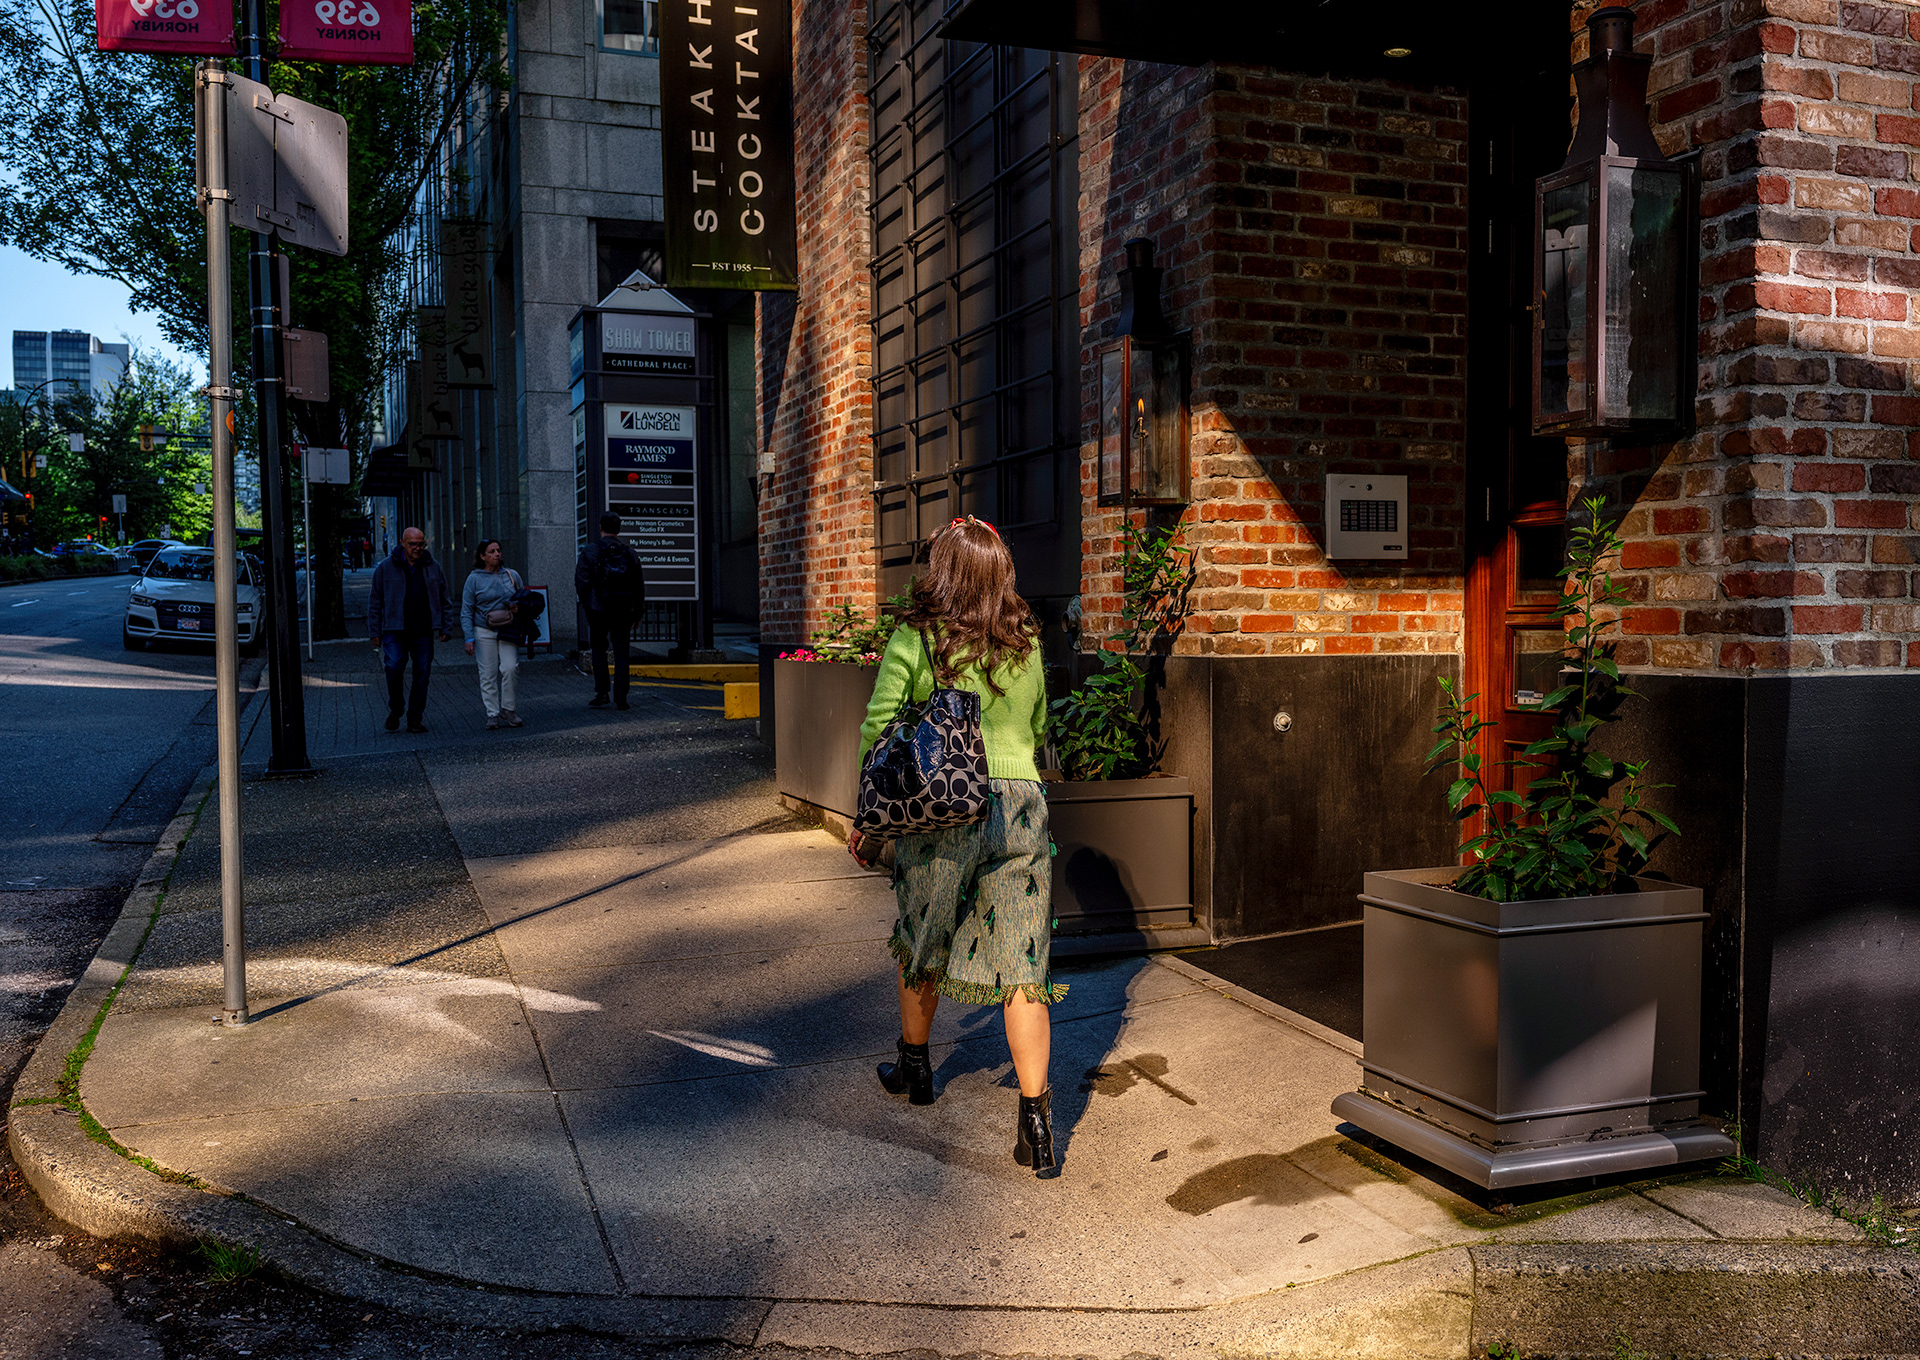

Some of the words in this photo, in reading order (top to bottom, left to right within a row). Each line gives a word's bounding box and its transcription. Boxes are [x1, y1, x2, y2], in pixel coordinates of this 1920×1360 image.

[712, 262, 730, 271] EST
[733, 263, 752, 272] 1955
[460, 280, 478, 333] black
[605, 327, 642, 350] SHAW
[647, 331, 691, 353] TOWER
[611, 359, 660, 369] CATHEDRAL
[662, 361, 688, 370] PLACE
[635, 411, 681, 422] LAWSON
[635, 421, 679, 431] LUNDELL
[625, 445, 676, 455] RAYMOND
[634, 454, 667, 463] JAMES
[629, 507, 689, 515] TRANSCEND
